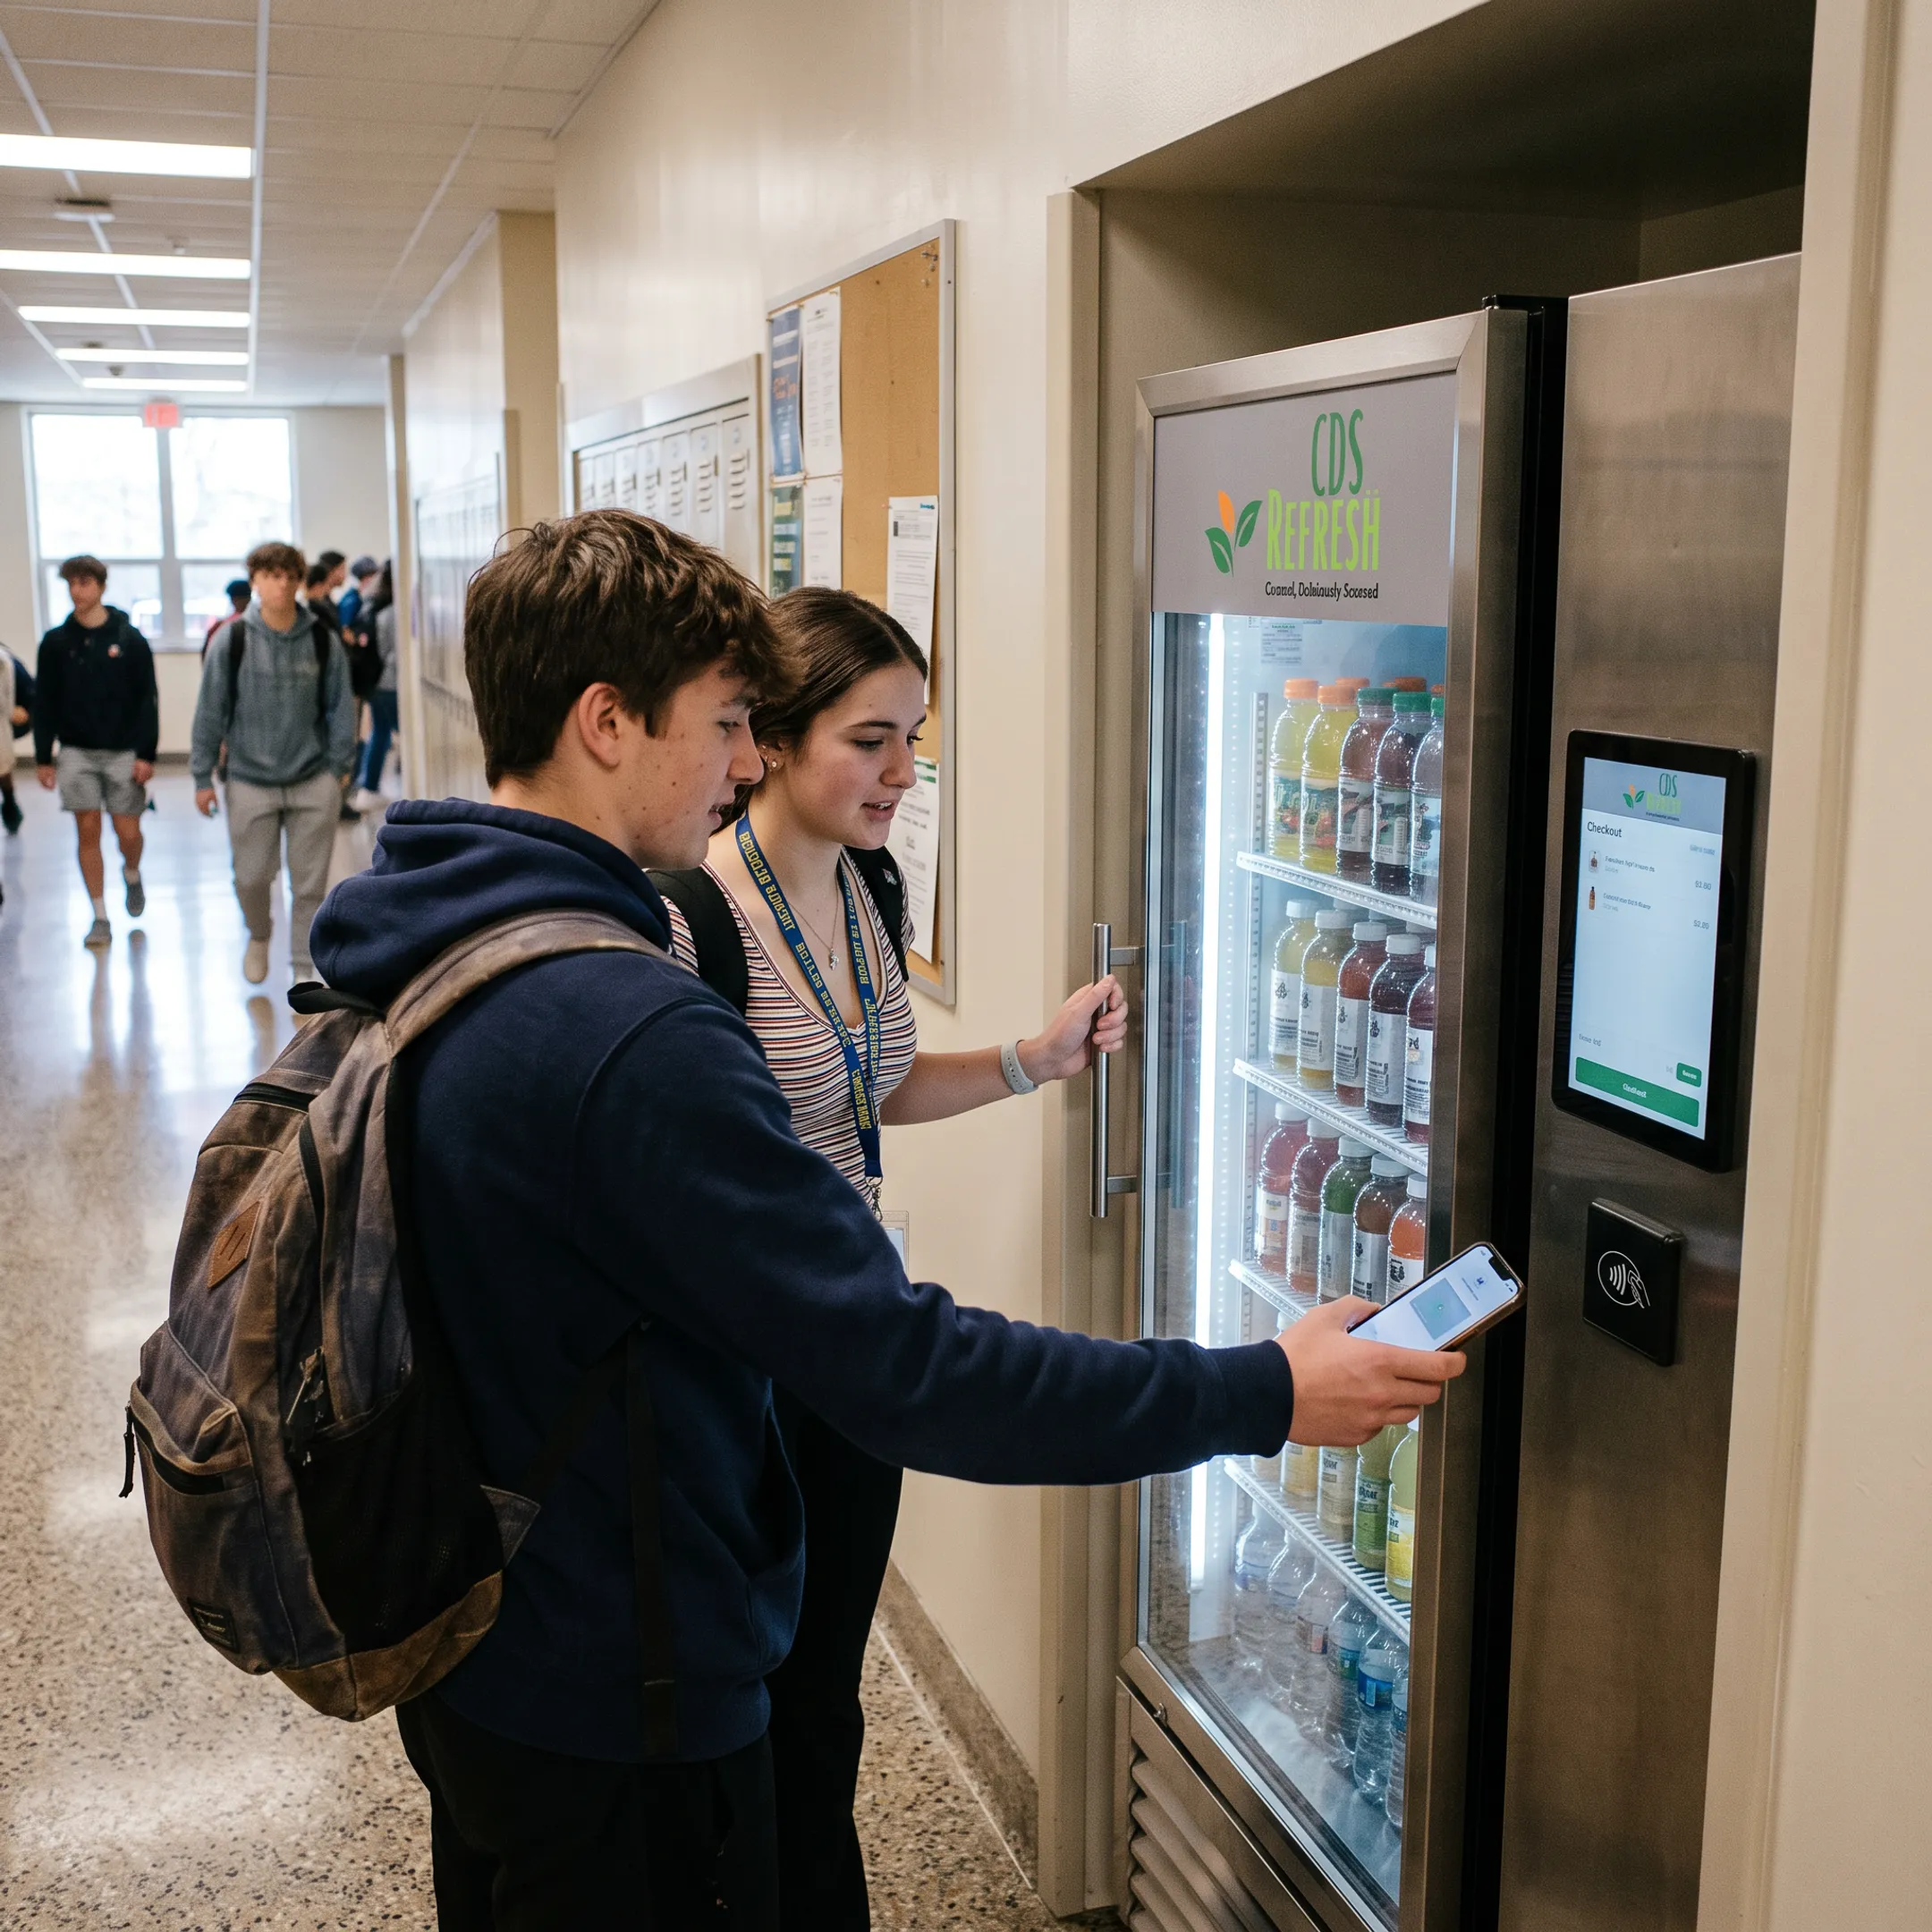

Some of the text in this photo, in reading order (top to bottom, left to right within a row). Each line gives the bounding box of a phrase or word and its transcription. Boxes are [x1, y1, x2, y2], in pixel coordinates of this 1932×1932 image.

[1311, 409, 1364, 496] CDS
[1658, 773, 1678, 798] CDS
[1587, 821, 1623, 838] Checkout
